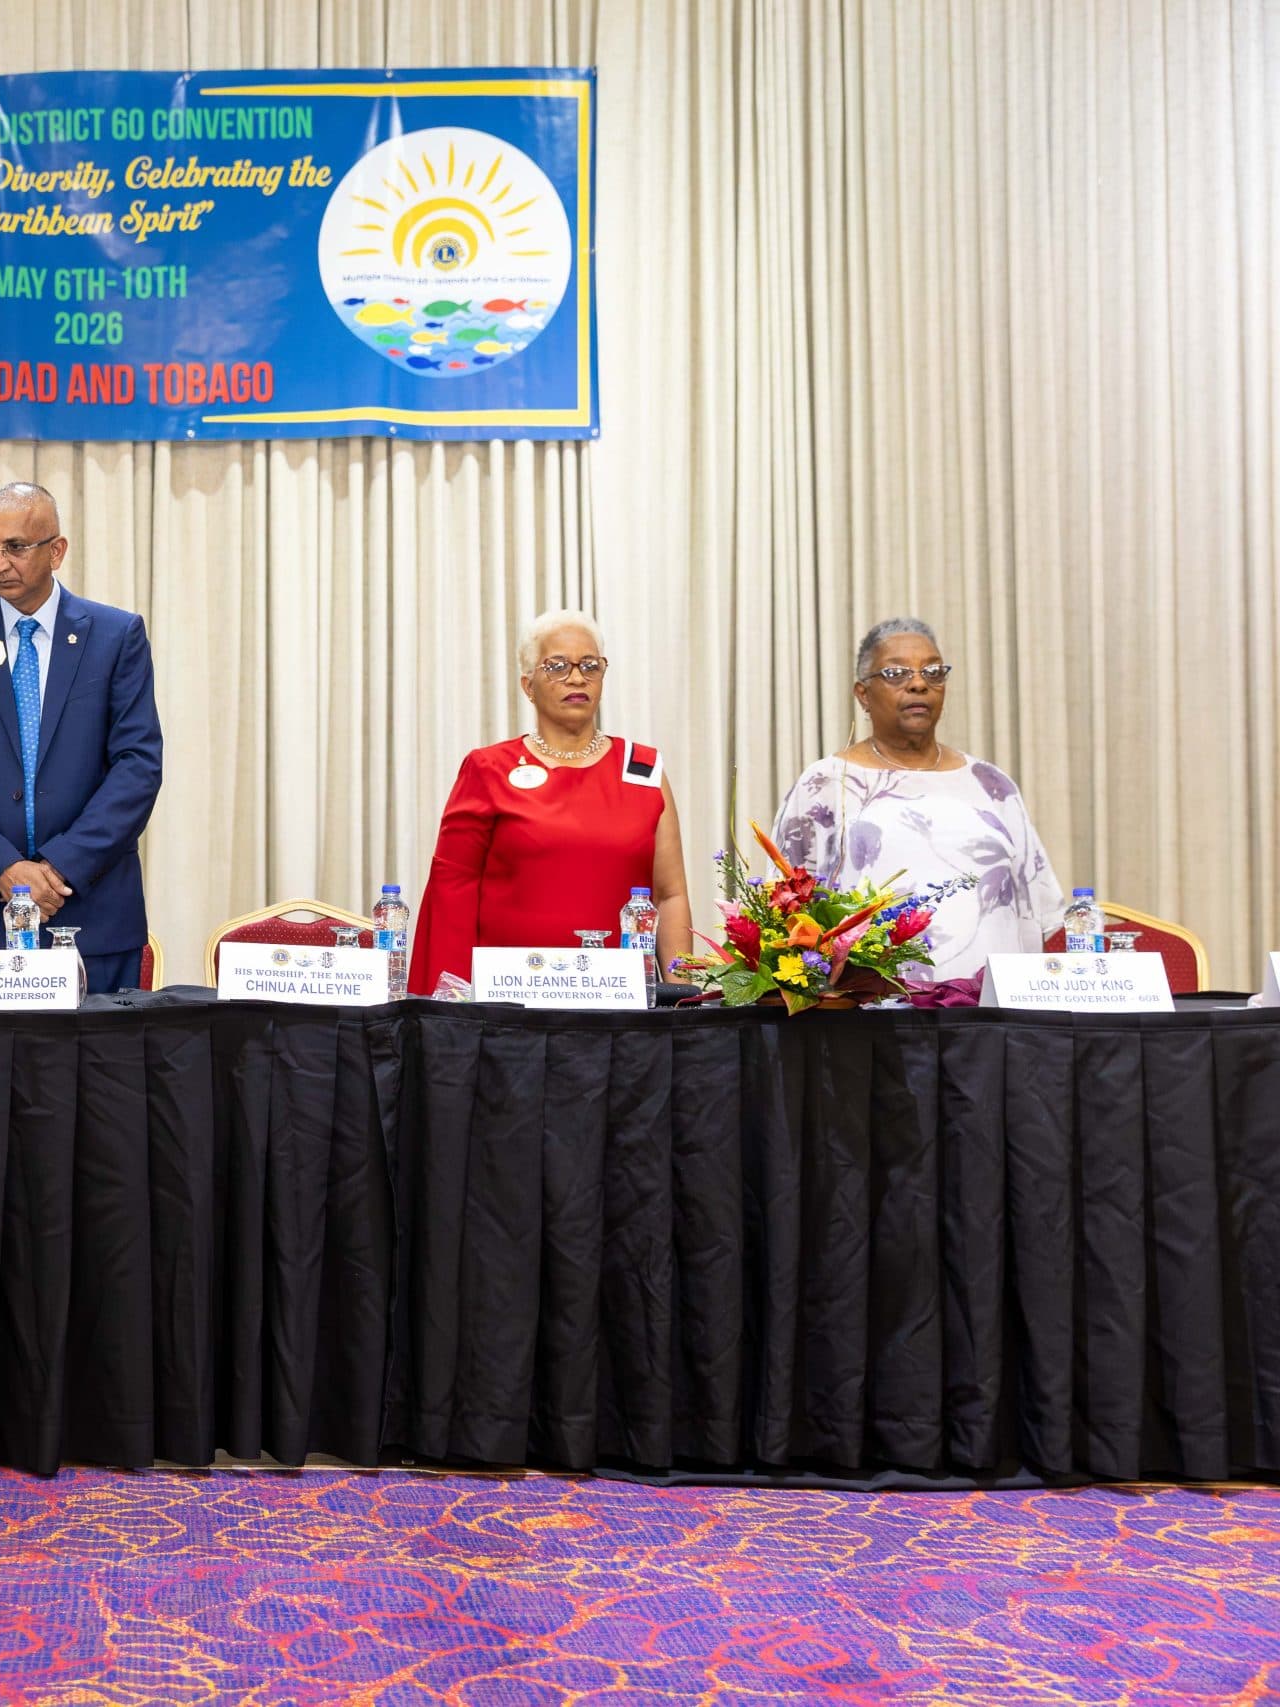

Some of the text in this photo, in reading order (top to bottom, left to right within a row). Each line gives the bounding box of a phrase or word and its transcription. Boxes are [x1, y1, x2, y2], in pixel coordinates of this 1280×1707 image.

[111, 108, 144, 141] 60
[152, 106, 313, 141] CONVENTION
[125, 156, 285, 196] Celebrating
[288, 155, 333, 187] the
[120, 200, 215, 244] Spirit”
[55, 311, 123, 345] 2026
[66, 362, 135, 404] AND
[143, 361, 274, 404] TOBAGO
[234, 967, 373, 981] HIS WORSHIP, THE MAYOR
[493, 975, 627, 988] LION JEANNE BLAIZE
[246, 979, 361, 996] CHINUA ALLEYNE
[1028, 980, 1133, 991] LION JUDY KING
[487, 990, 538, 999] DISTRICT
[542, 991, 602, 1000] GOVERNOR
[614, 992, 635, 1000] 60A
[1009, 994, 1060, 1003] DISTRICT
[1065, 994, 1126, 1003] GOVERNOR
